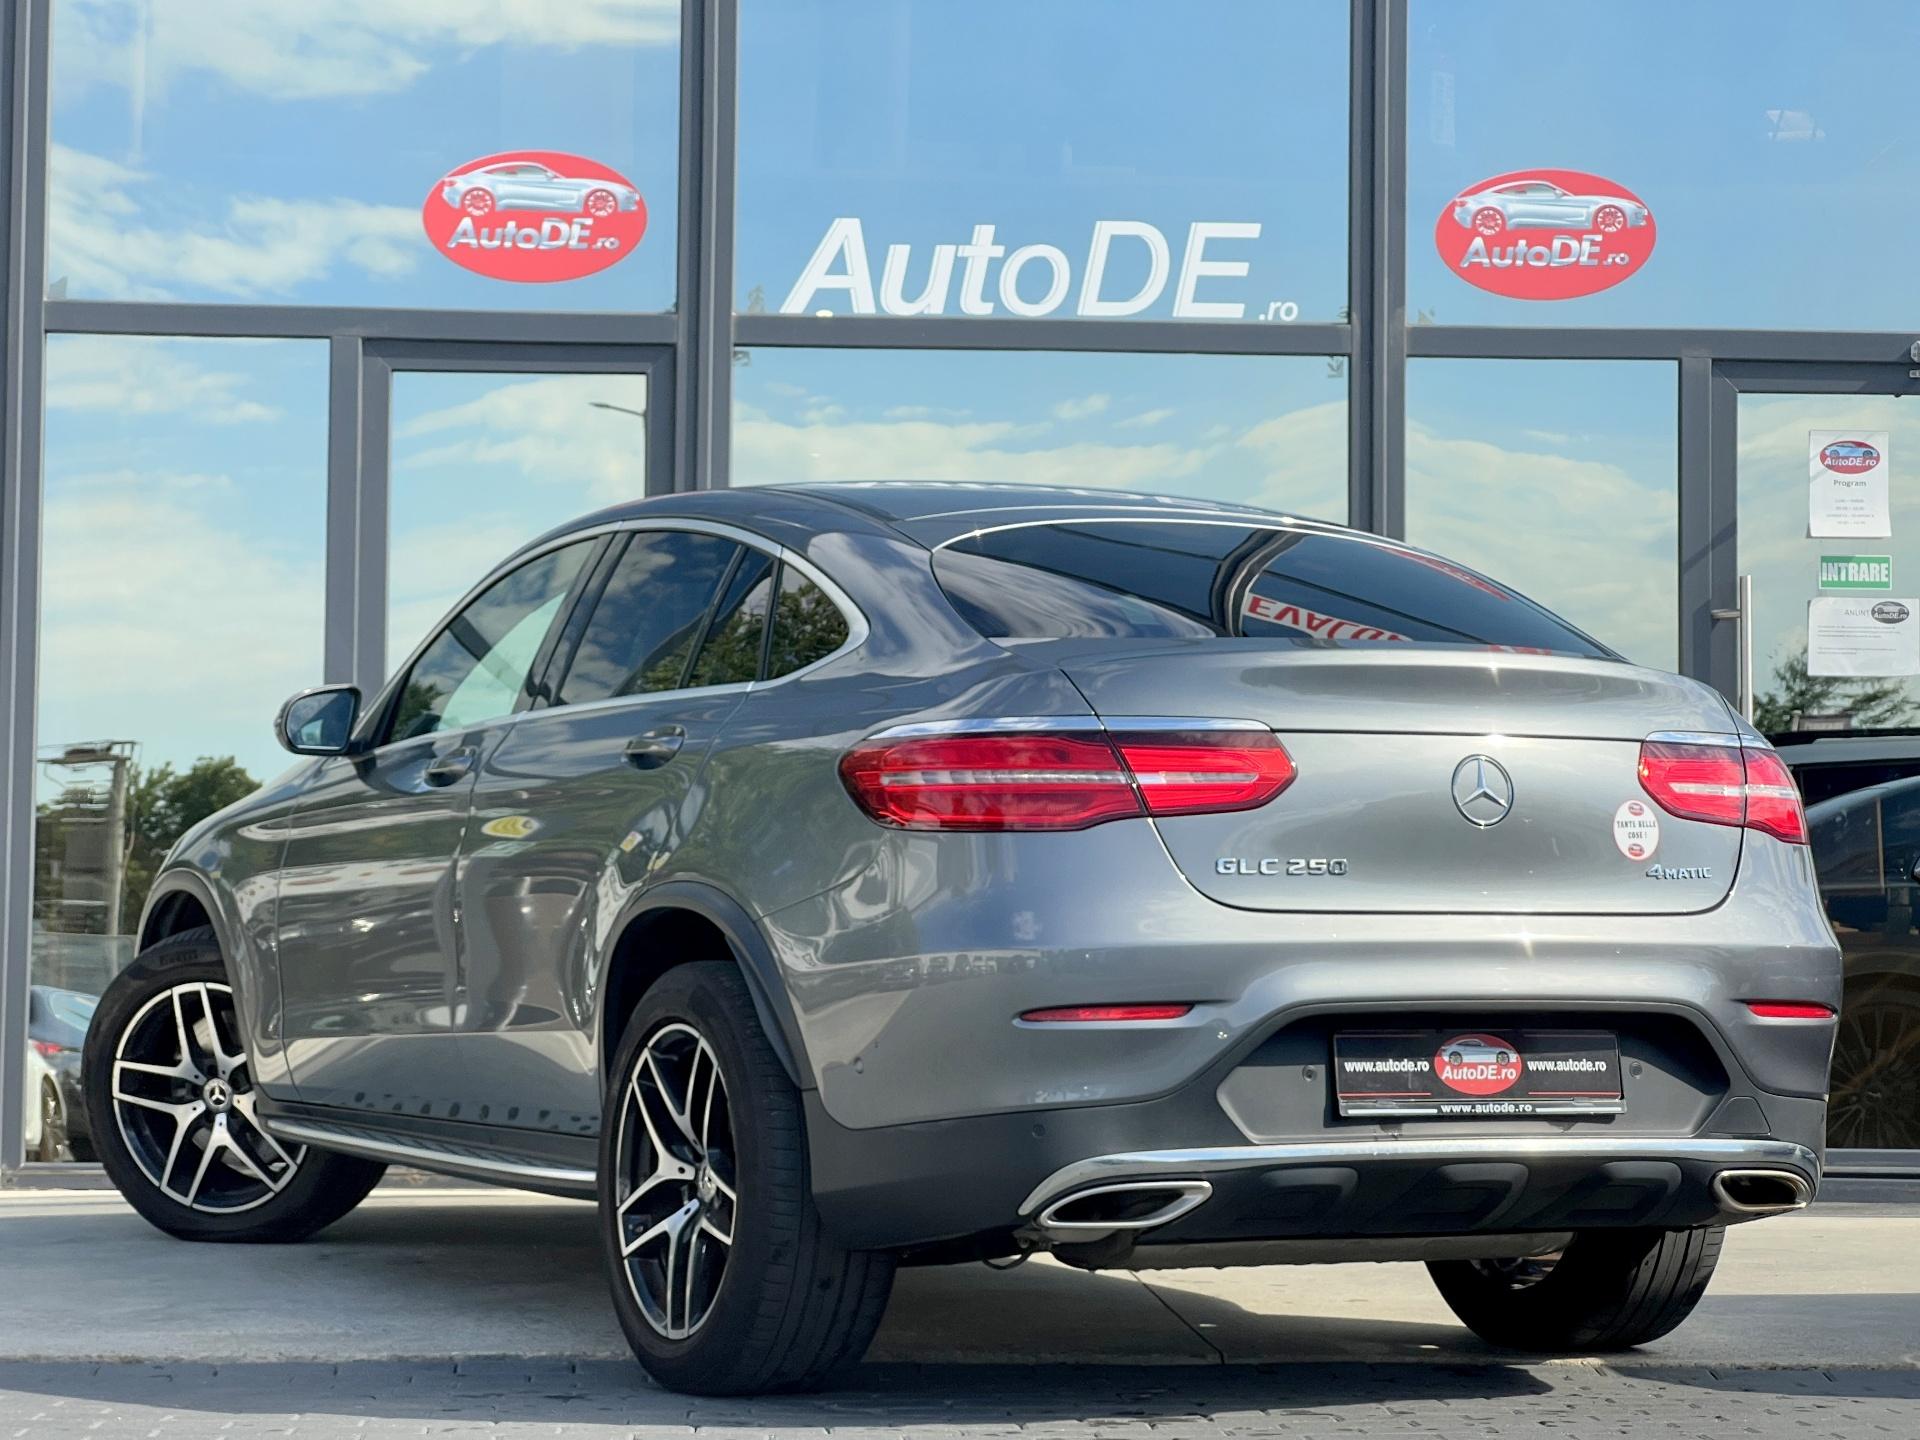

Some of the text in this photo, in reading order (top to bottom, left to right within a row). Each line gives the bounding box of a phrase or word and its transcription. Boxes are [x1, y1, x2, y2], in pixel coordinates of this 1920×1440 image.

[1824, 457, 1877, 467] AutoDE.ro
[1822, 562, 1889, 582] INTRARE
[1215, 857, 1348, 876] GLC 250
[1645, 863, 1713, 880] 4MATIC
[1344, 1061, 1430, 1073] www.autode.ro
[1441, 1064, 1517, 1081] AutoDE.ro
[1527, 1061, 1607, 1073] www.autode.ro
[1440, 1103, 1533, 1114] www.autode.ro
